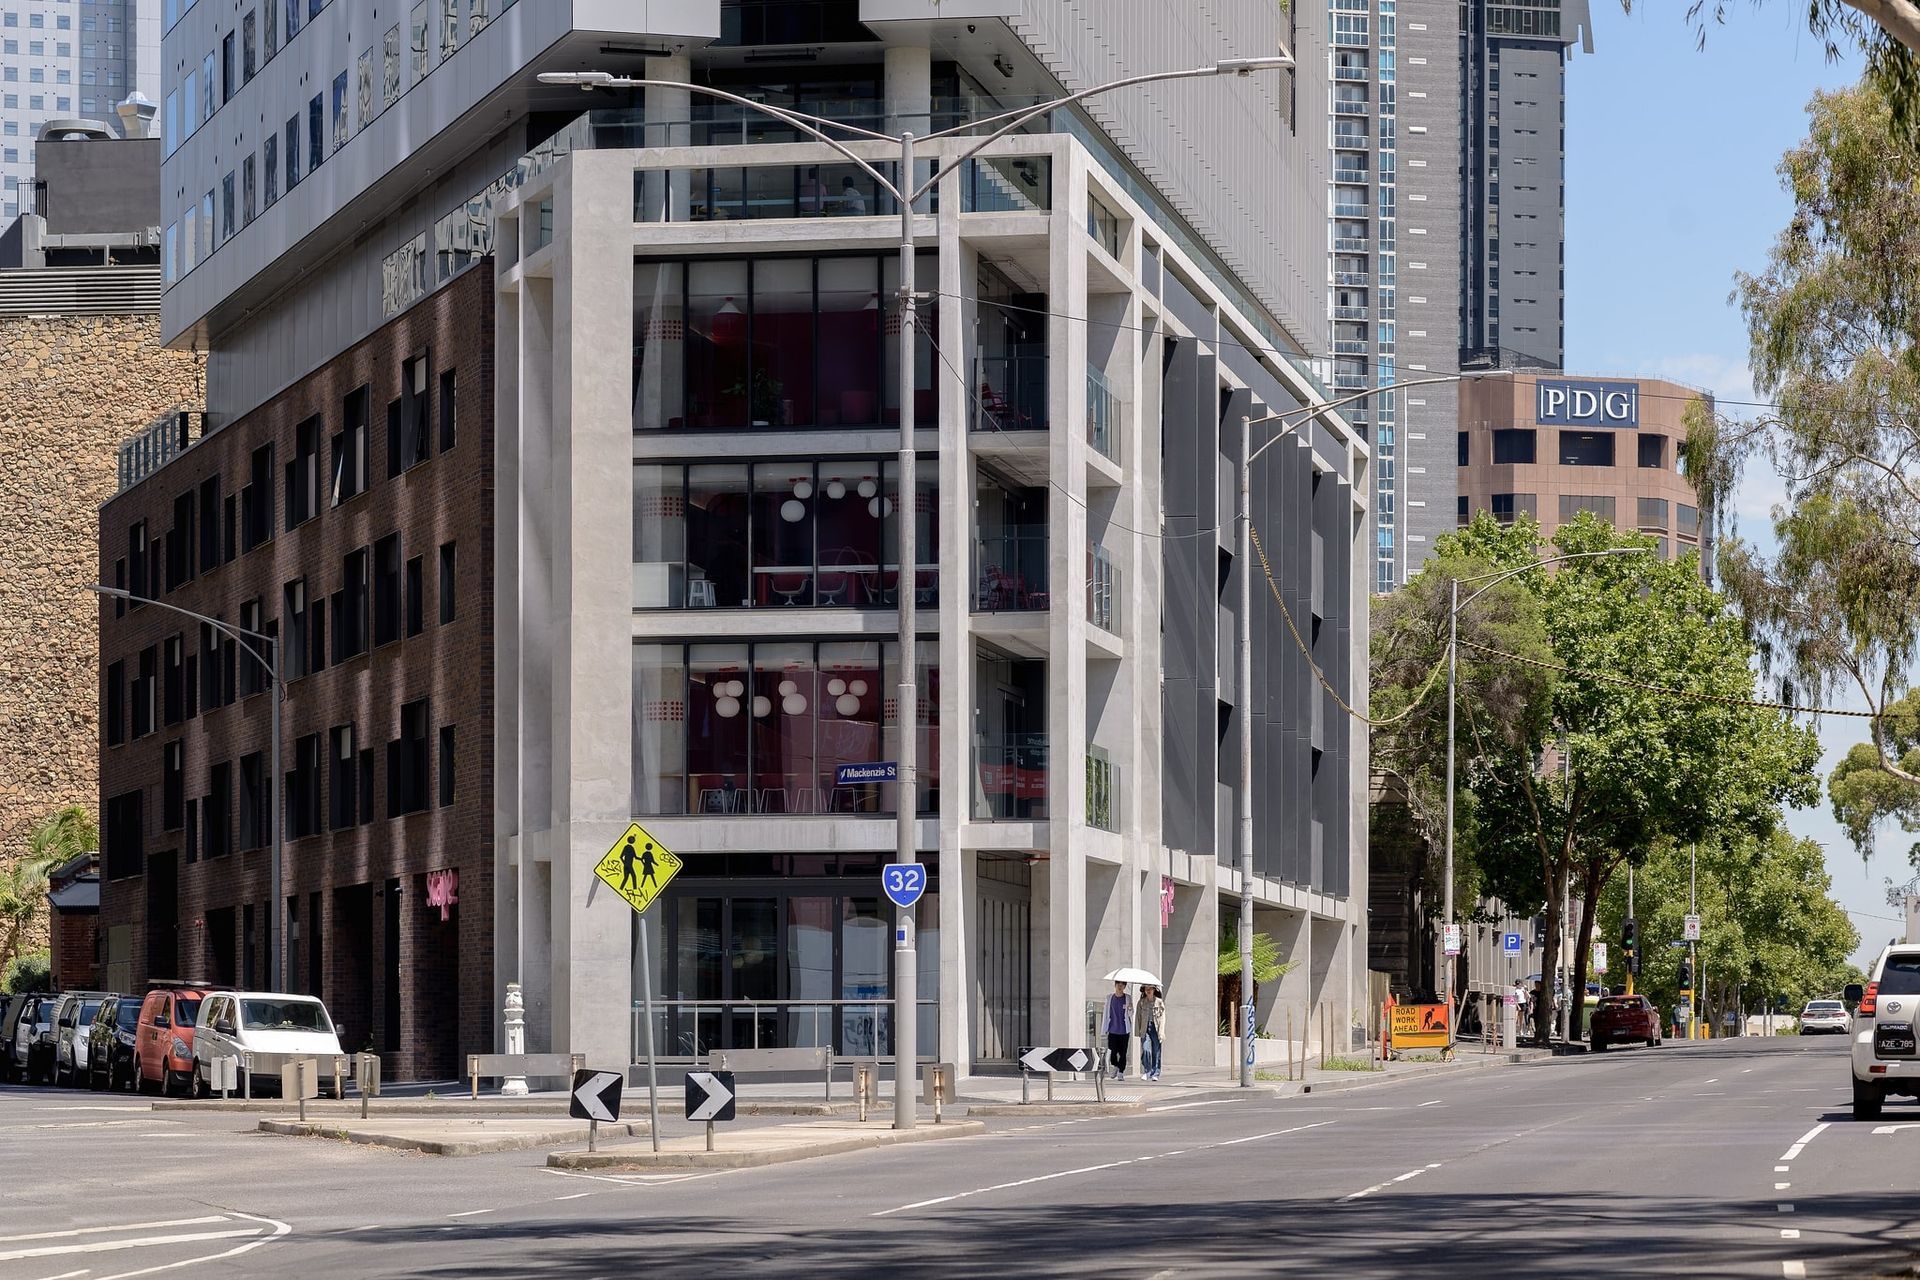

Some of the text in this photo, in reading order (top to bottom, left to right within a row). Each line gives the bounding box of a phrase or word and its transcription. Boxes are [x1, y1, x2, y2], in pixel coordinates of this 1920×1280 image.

[1545, 388, 1630, 419] PDG
[846, 766, 896, 778] Mackenzie St
[889, 869, 919, 892] 32
[1508, 936, 1517, 948] P
